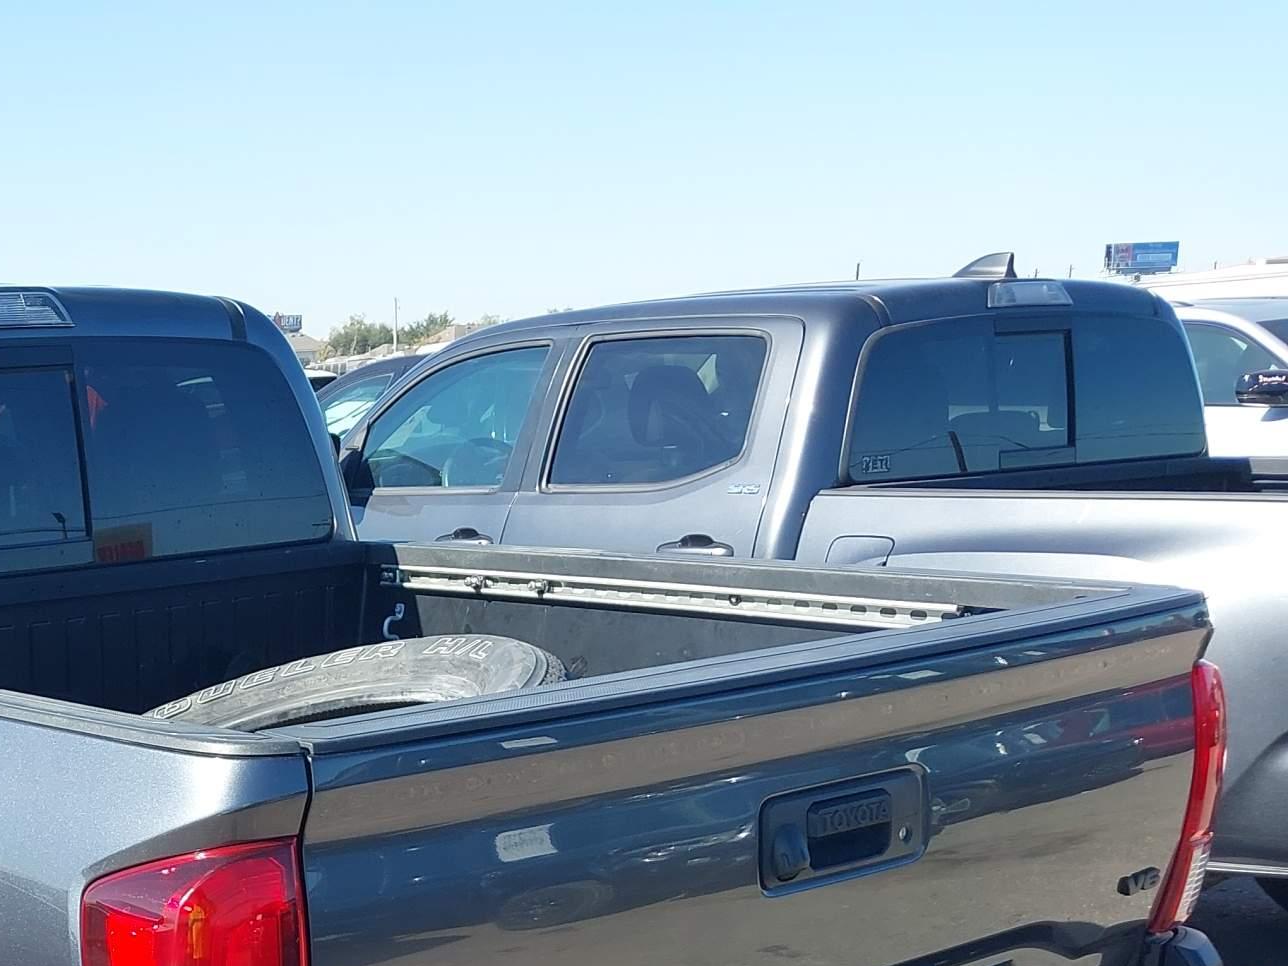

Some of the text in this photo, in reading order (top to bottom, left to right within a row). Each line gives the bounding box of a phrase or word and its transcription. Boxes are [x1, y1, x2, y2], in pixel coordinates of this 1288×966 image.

[153, 637, 493, 720] DUELER H/L
[821, 801, 891, 833] TOYOTA
[1120, 866, 1161, 896] V6
